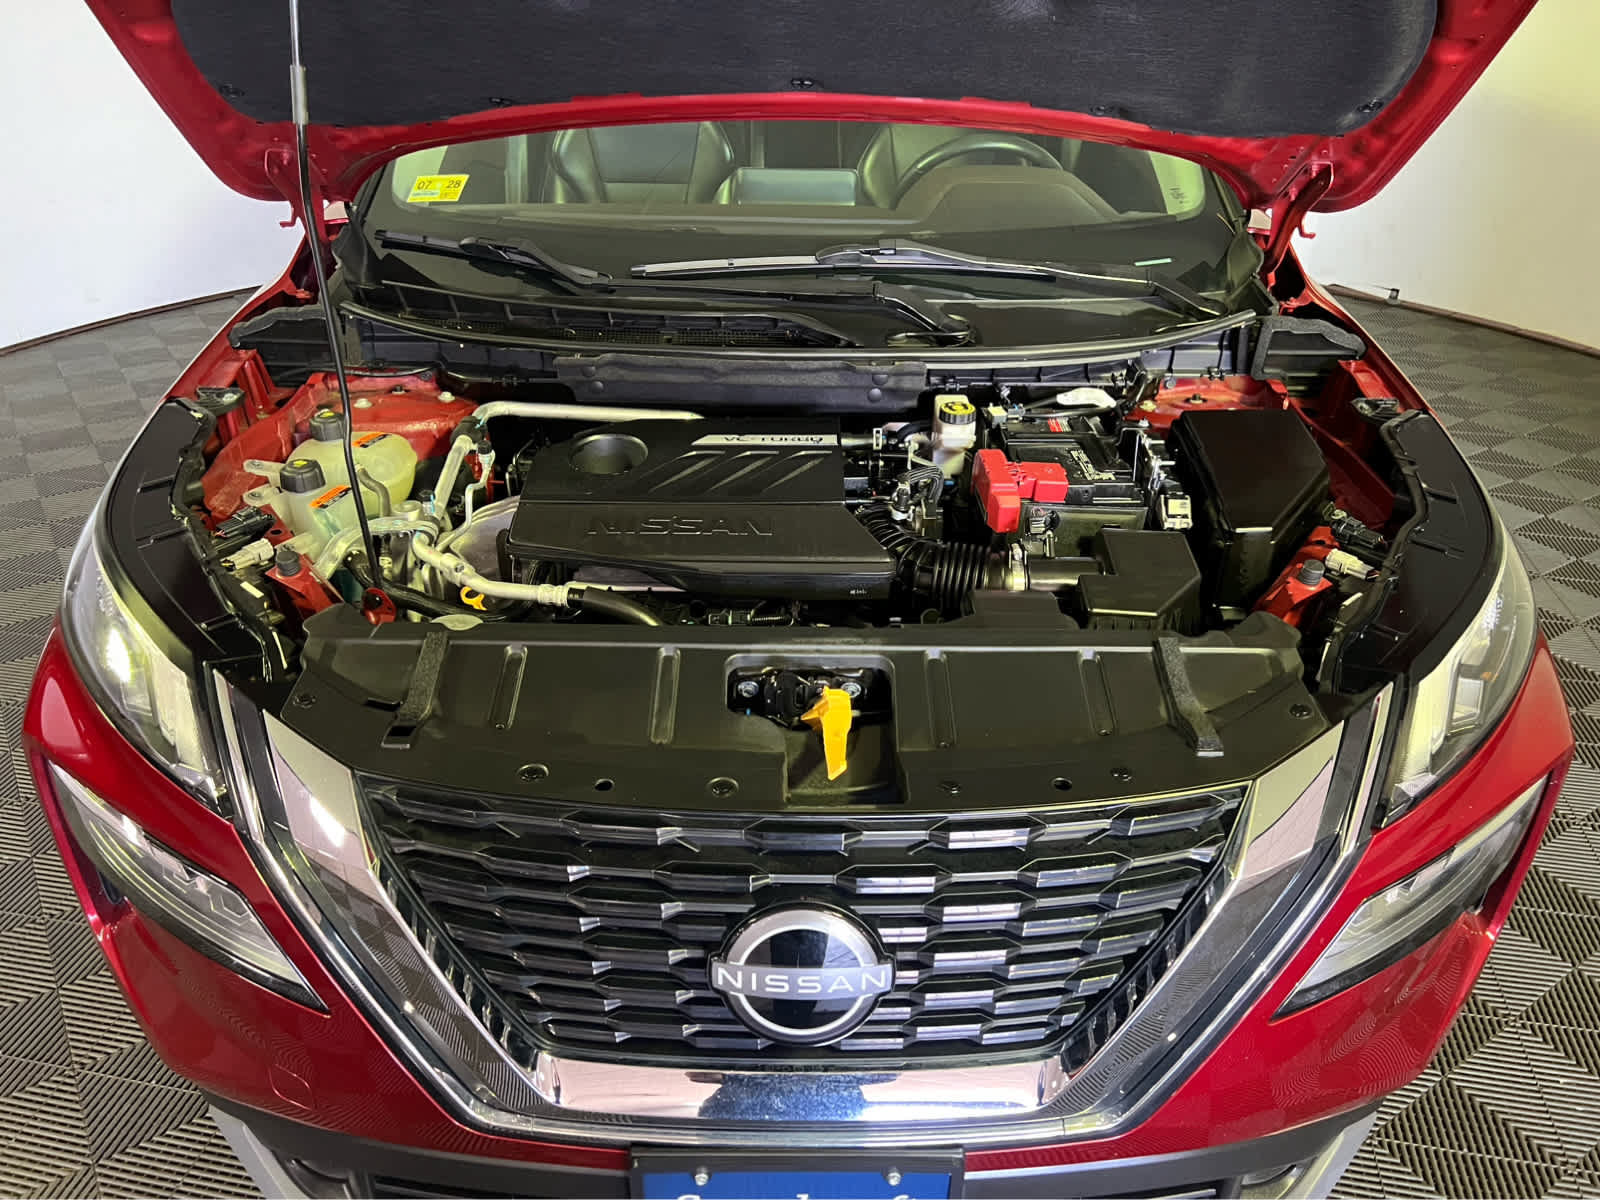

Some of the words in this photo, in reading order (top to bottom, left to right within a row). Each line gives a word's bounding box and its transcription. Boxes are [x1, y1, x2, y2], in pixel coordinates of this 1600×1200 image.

[417, 180, 432, 190] 07
[587, 516, 773, 536] NISSAN
[717, 967, 886, 993] NISSAN
